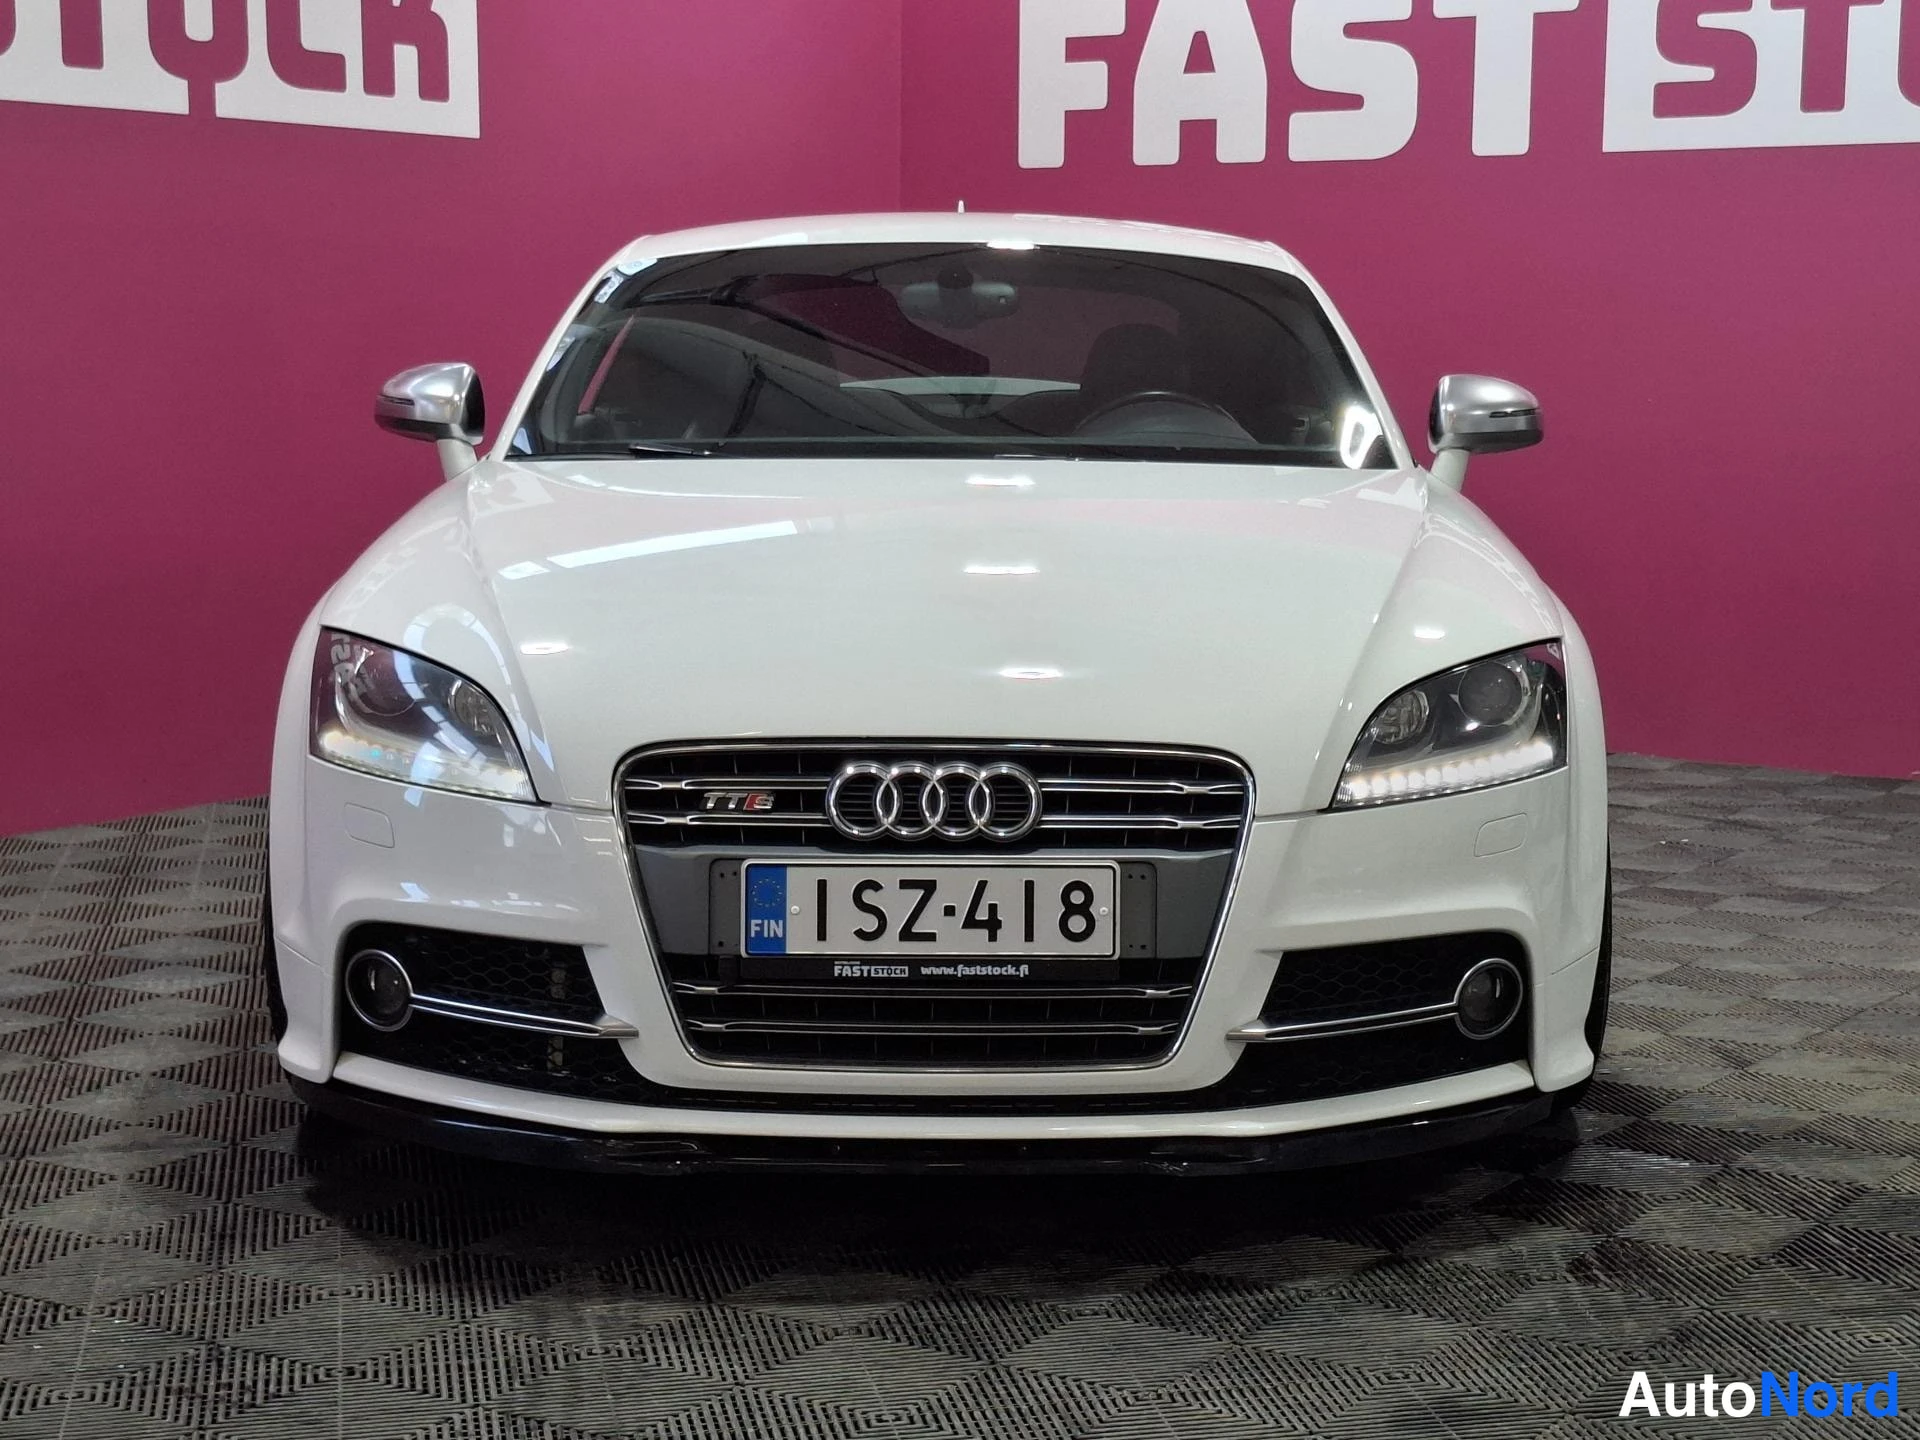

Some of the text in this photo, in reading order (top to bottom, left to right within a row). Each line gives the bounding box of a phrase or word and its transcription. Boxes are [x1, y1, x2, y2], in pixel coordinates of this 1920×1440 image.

[1018, 0, 1920, 168] FAST ST
[704, 792, 775, 811] TTS
[750, 919, 784, 939] FIN
[834, 965, 908, 977] FAST STOCK
[920, 964, 1029, 978] www.faststock.fi
